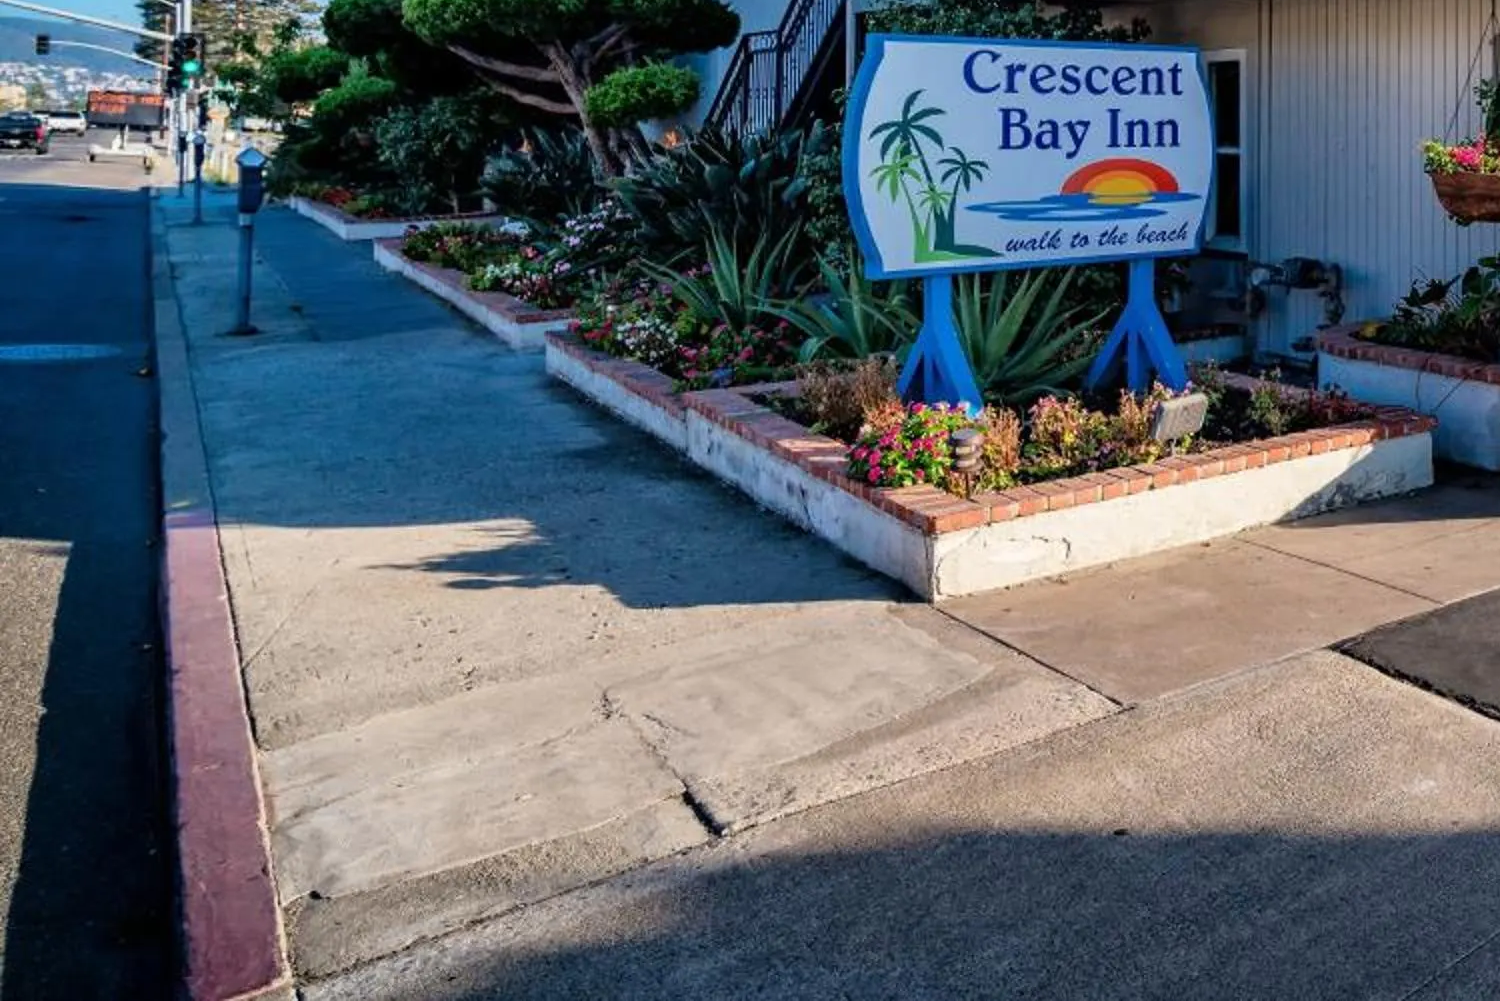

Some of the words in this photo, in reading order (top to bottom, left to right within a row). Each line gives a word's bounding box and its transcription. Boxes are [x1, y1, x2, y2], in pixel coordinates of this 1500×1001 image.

[963, 49, 1183, 96] Crescent
[998, 107, 1091, 159] Bay
[1106, 108, 1181, 148] Inn
[1005, 228, 1062, 253] walk
[1070, 231, 1090, 249] to
[1098, 224, 1127, 246] the
[1135, 221, 1188, 244] beach
